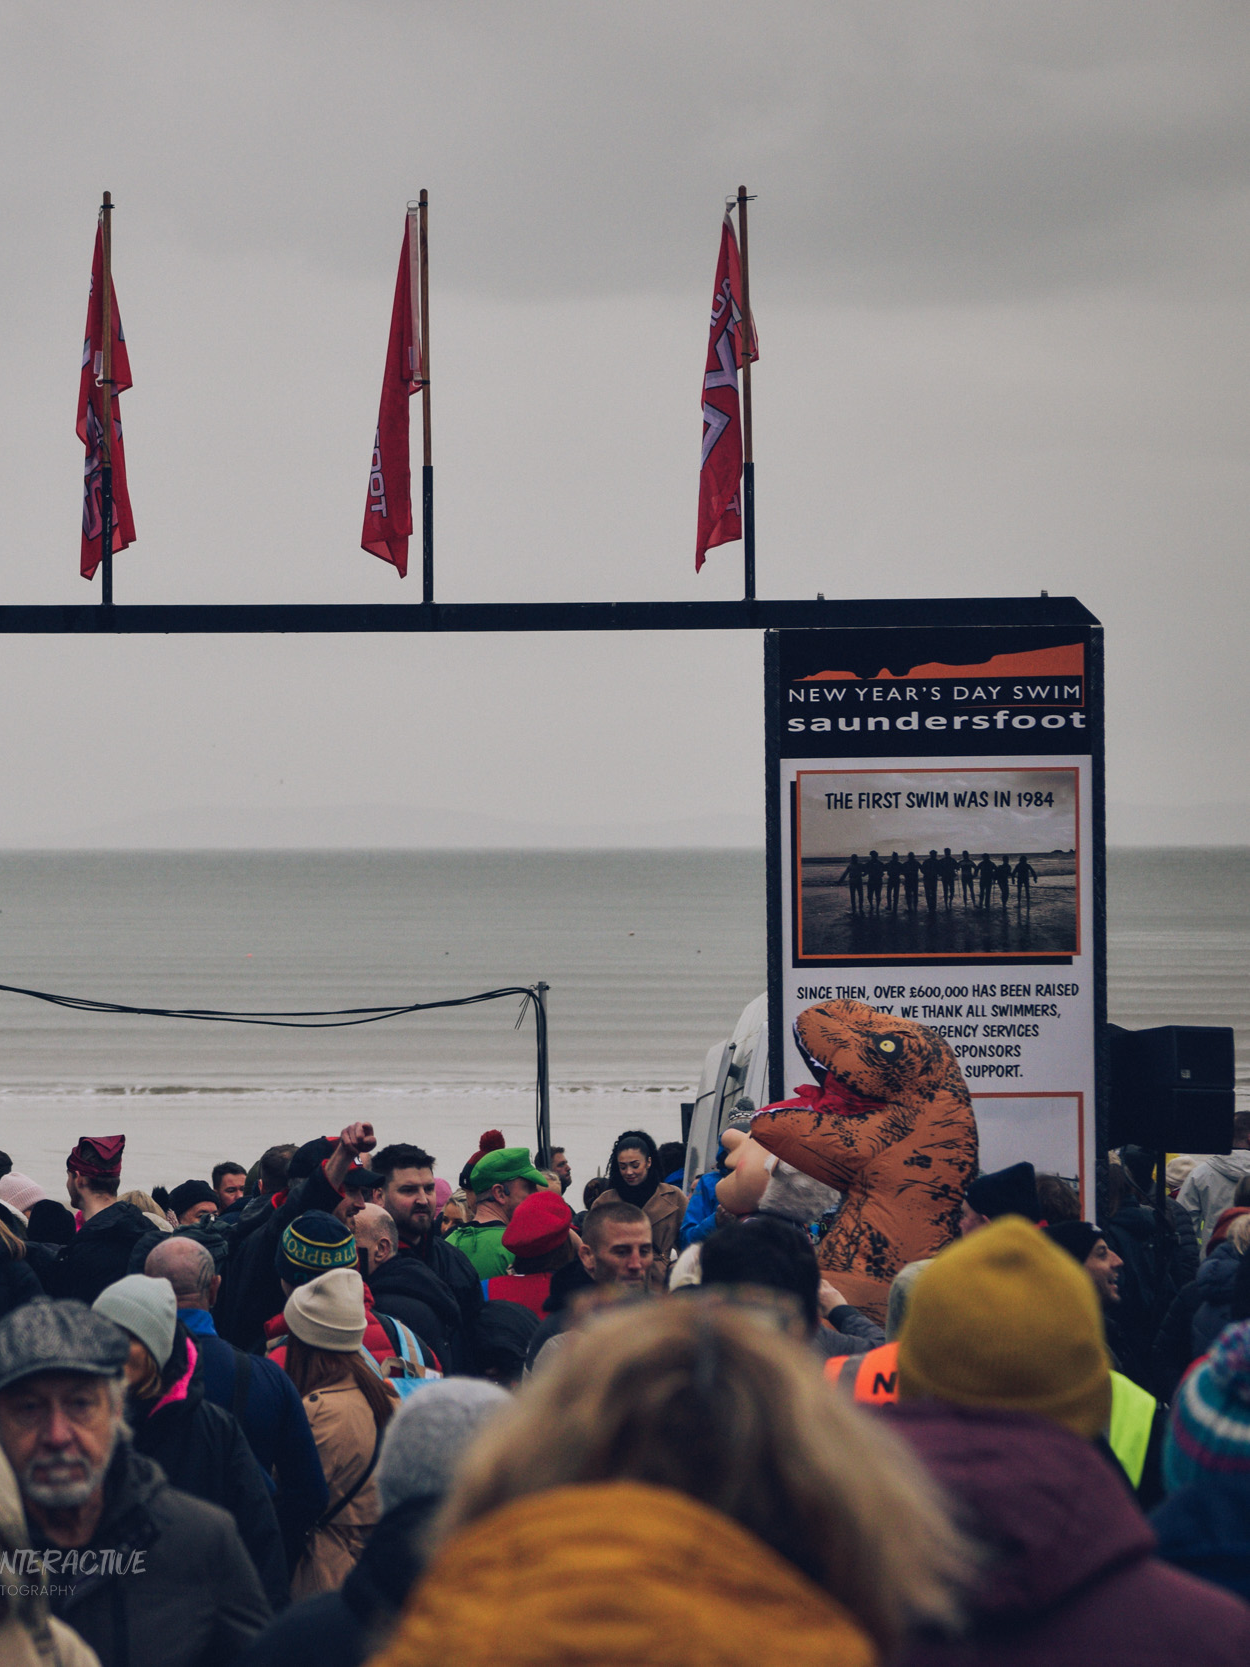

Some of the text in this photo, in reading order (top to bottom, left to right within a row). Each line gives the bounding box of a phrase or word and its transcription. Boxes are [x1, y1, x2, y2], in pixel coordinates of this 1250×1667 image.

[788, 685, 1081, 703] NEW YEAR'S DAY SWIM
[787, 710, 1086, 732] saundersfoot
[825, 790, 1055, 810] THE FIRST SWIM WAS IN 1984
[797, 983, 1080, 1000] SINCE THEN, OVER £600,000 HAS BEEN RAISED
[901, 1005, 919, 1018] WE
[922, 1004, 963, 1018] THANK
[966, 1004, 987, 1018] ALL
[991, 1004, 1061, 1018] SWIMMERS,
[982, 1024, 1040, 1037] SERVICES
[954, 1044, 1021, 1058] SPONSORS
[964, 1064, 1024, 1078] SUPPORT.
